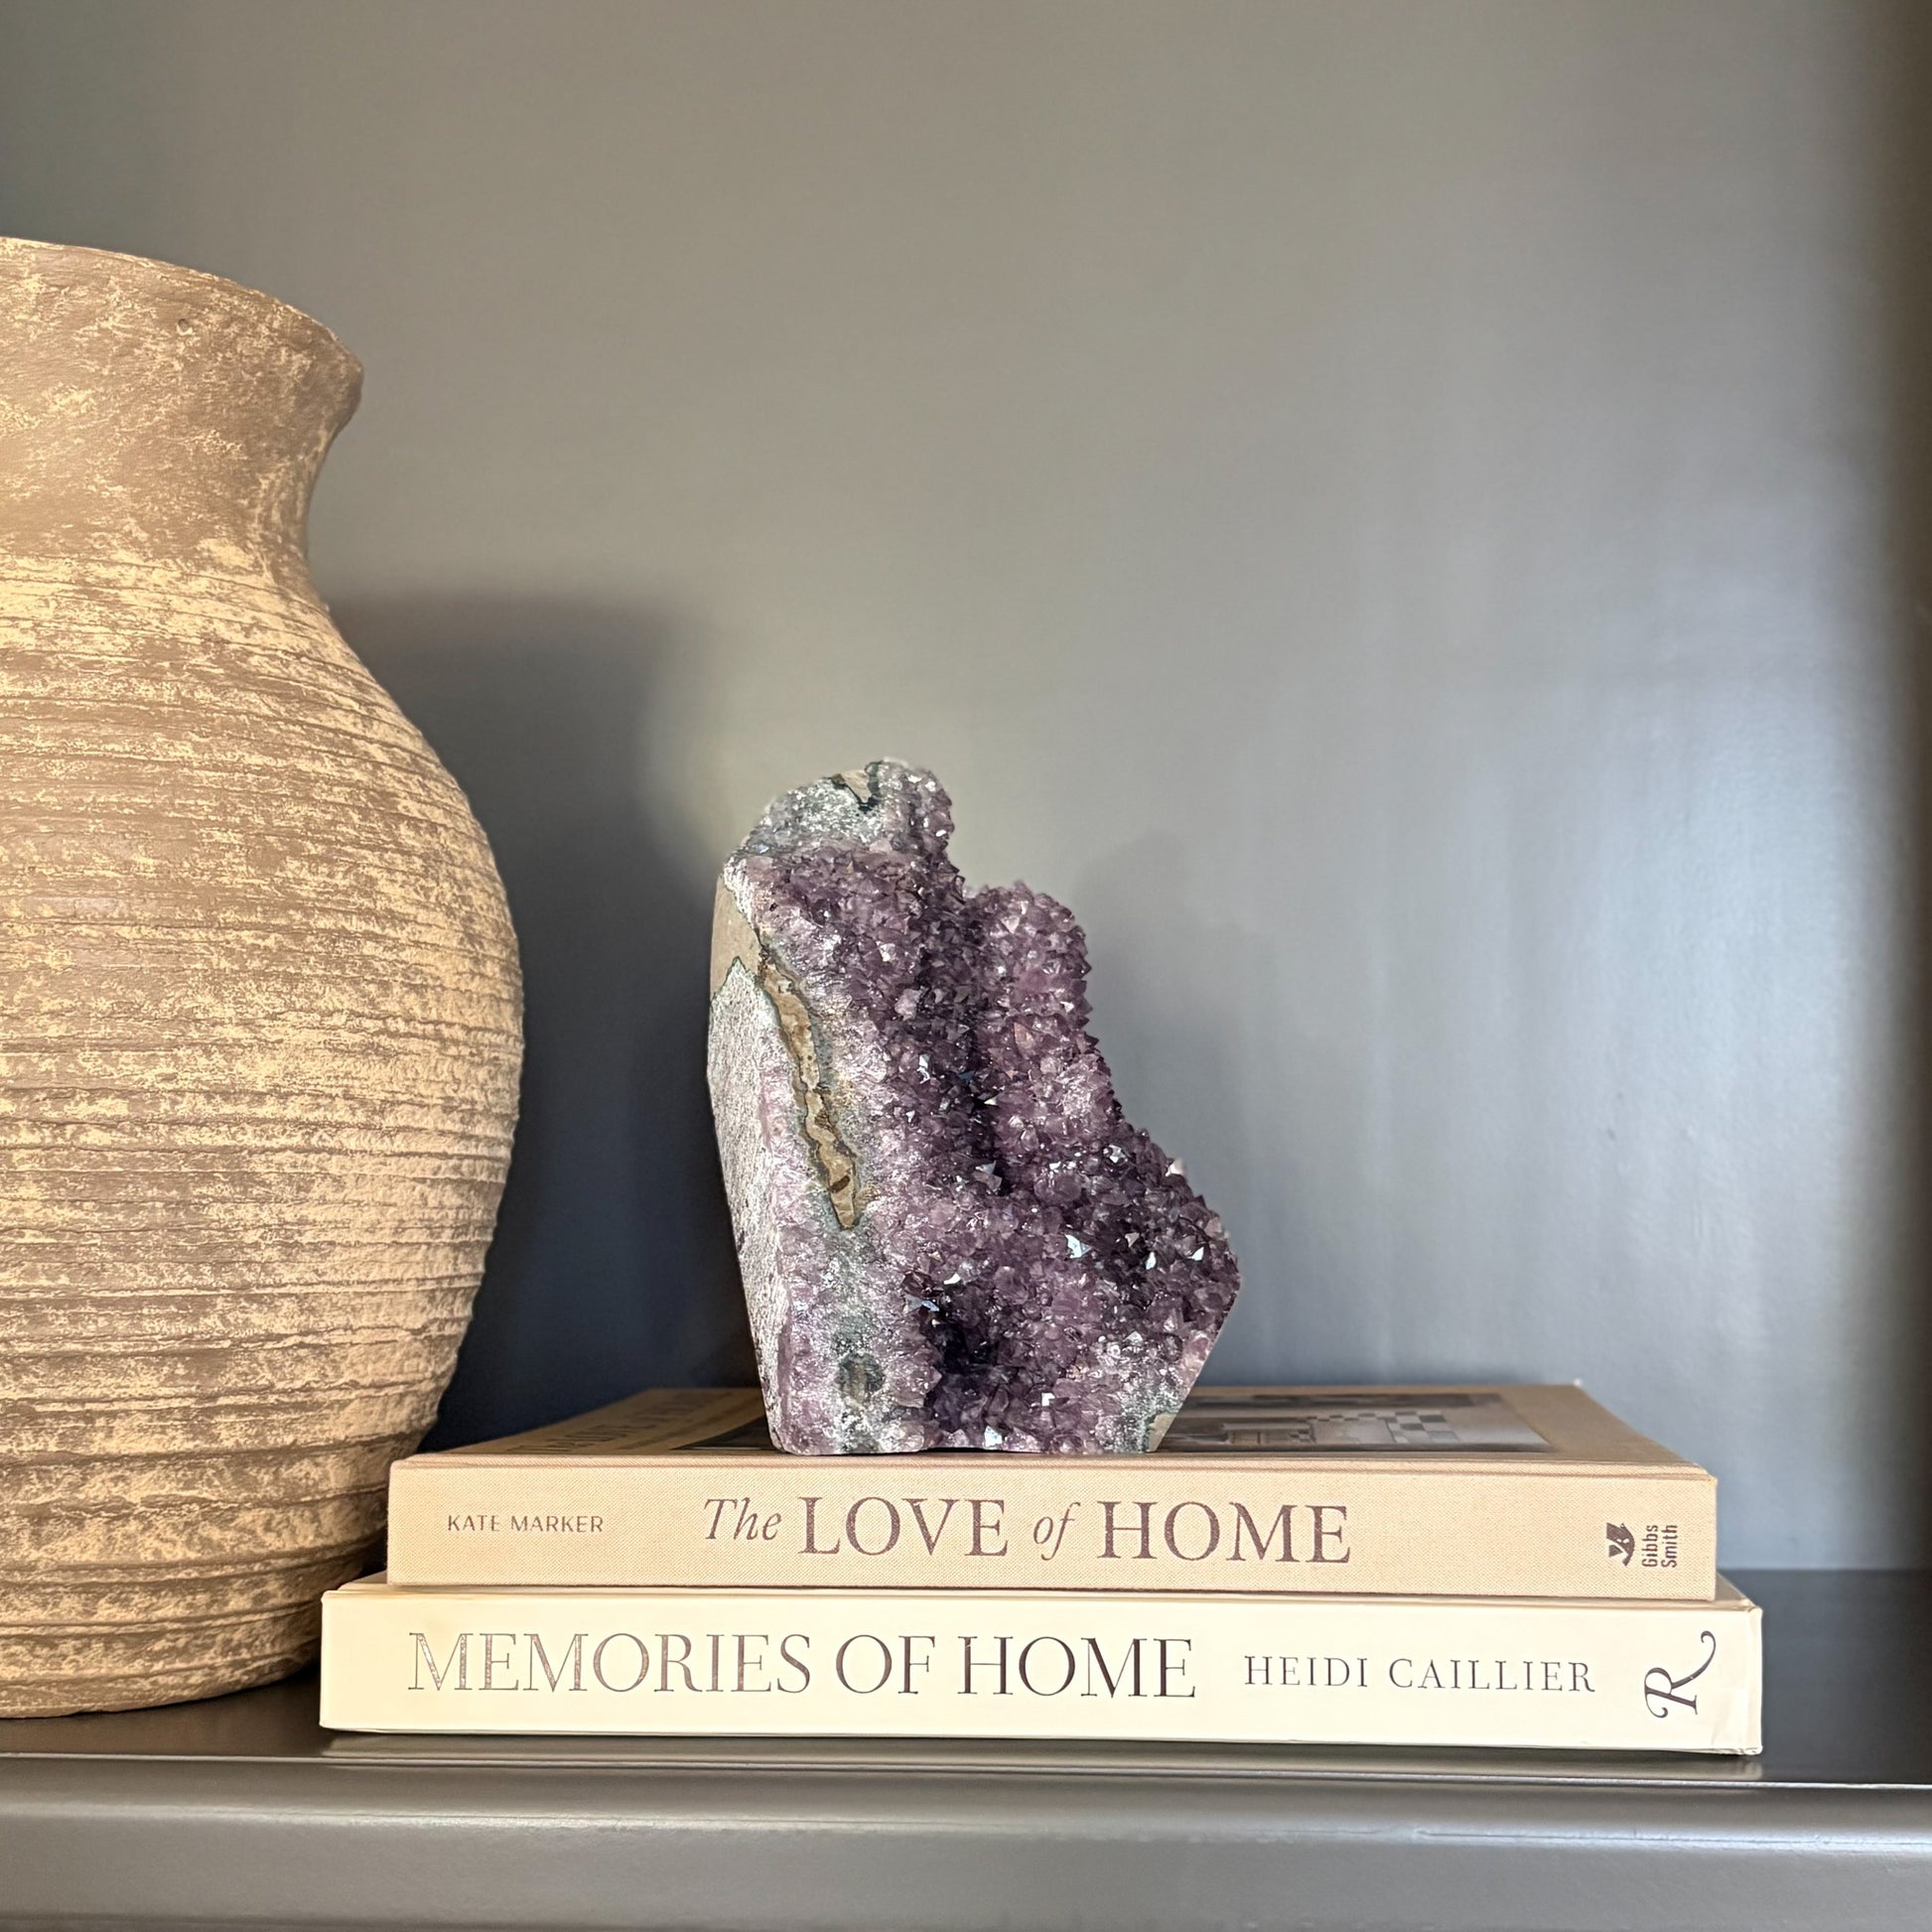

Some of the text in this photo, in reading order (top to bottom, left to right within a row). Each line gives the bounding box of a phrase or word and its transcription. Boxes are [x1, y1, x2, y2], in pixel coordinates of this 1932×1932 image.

[447, 1514, 604, 1534] KATE MARKER
[703, 1496, 1351, 1564] The LOVE of HOME
[1641, 1524, 1659, 1568] Gibbs
[1661, 1524, 1678, 1568] Smith
[407, 1632, 1196, 1699] MEMORIES OF HOME
[1243, 1655, 1596, 1693] HEIDI CAILLIER
